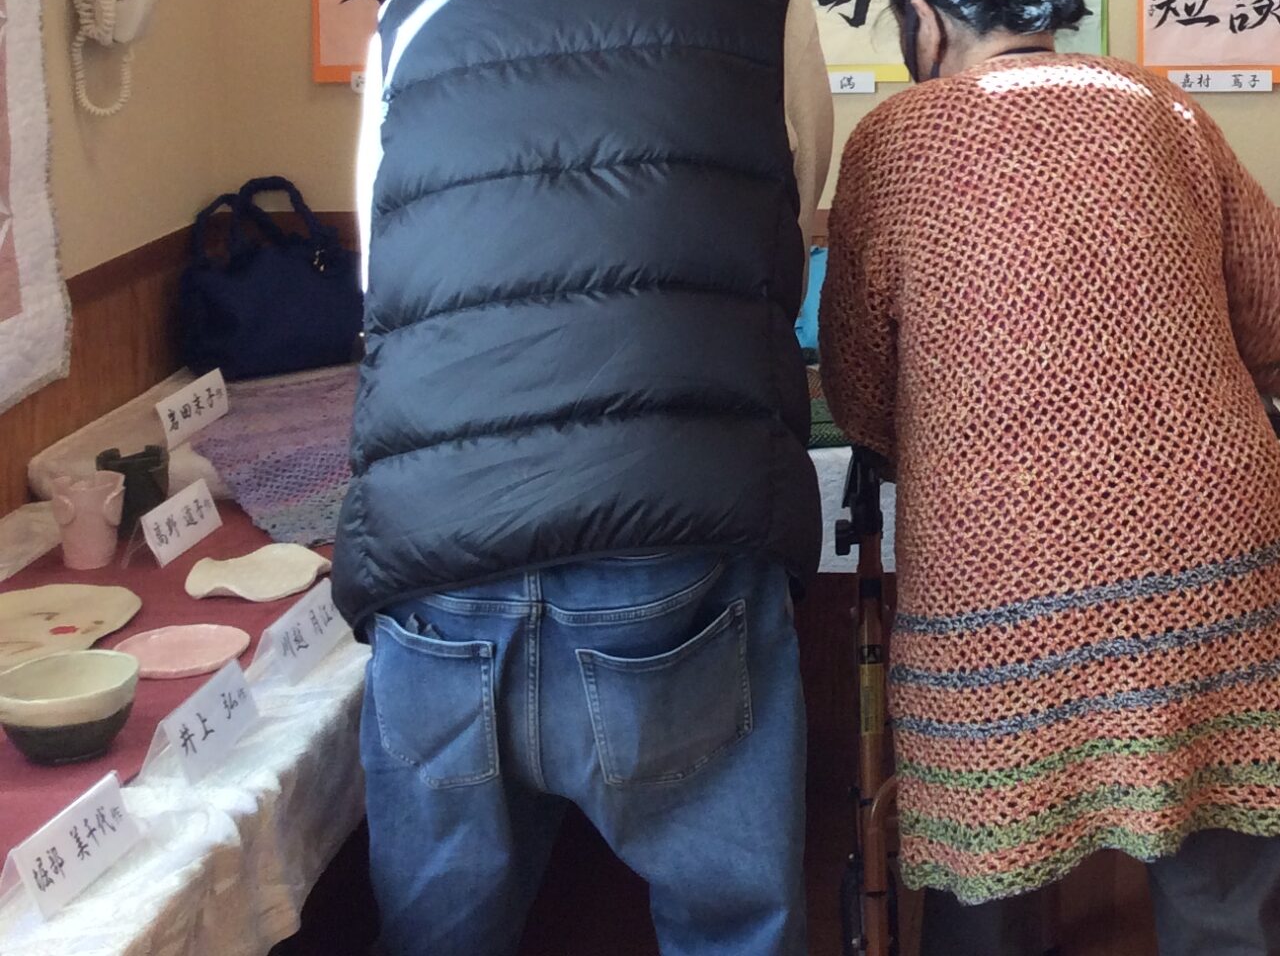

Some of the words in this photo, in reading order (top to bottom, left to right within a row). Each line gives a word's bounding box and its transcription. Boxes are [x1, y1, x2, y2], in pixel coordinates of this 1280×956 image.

[839, 77, 856, 92] 満
[180, 713, 215, 756] 井上
[32, 845, 66, 893] 堀部
